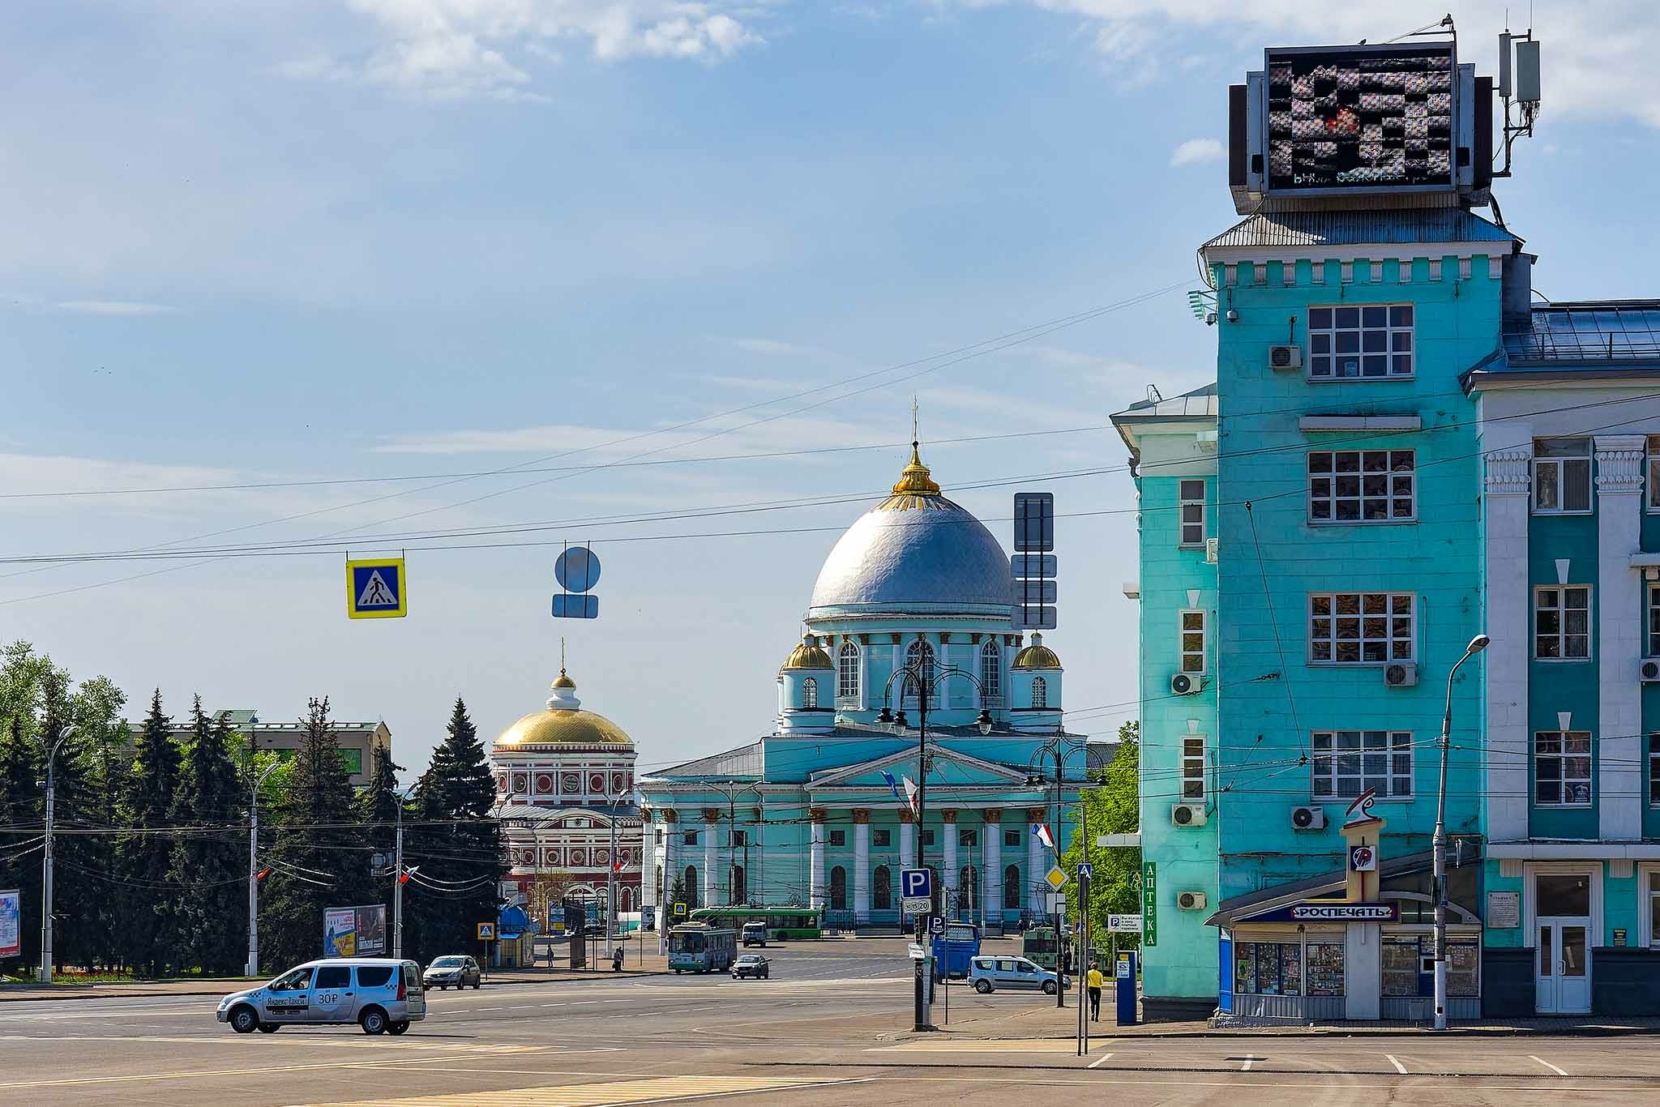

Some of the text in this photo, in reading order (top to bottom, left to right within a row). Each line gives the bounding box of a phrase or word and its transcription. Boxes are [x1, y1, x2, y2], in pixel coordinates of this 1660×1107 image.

[908, 872, 925, 895] P
[1146, 865, 1155, 945] АПТЕКА
[1300, 908, 1385, 917] РОСПЕЧАТЬ
